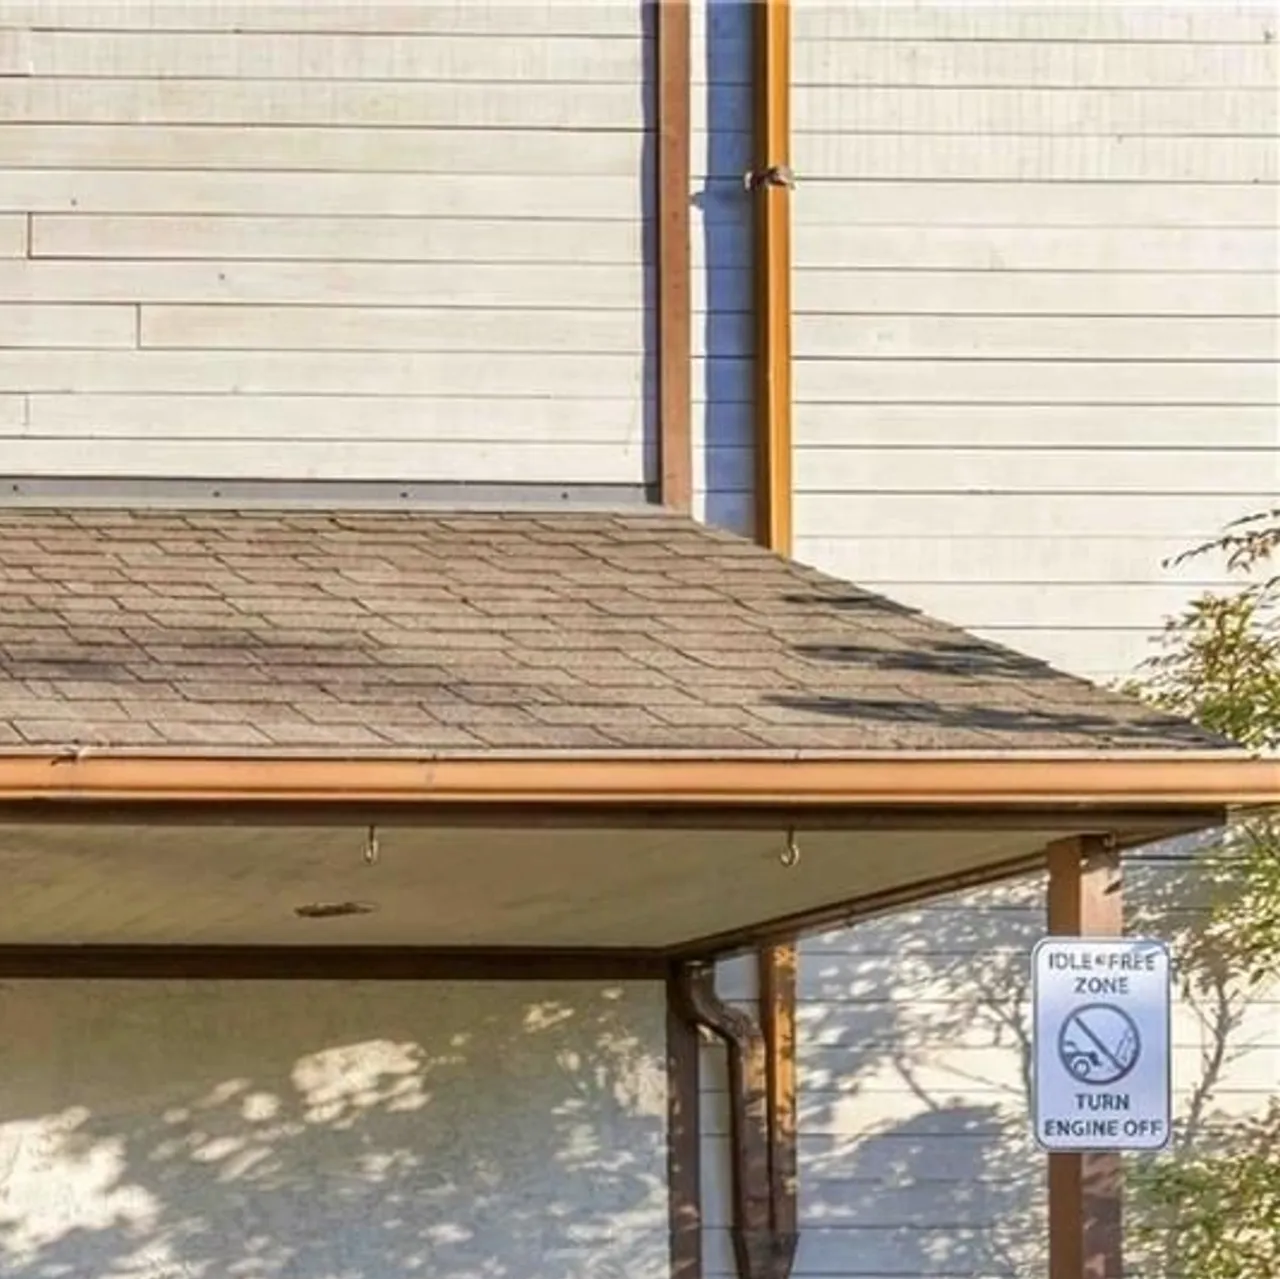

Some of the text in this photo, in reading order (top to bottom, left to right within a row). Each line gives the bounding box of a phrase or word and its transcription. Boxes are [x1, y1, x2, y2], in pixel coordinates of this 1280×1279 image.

[1074, 977, 1130, 995] ZONE
[1074, 1093, 1130, 1111] TURN
[1044, 1119, 1163, 1137] ENGINE OFF
